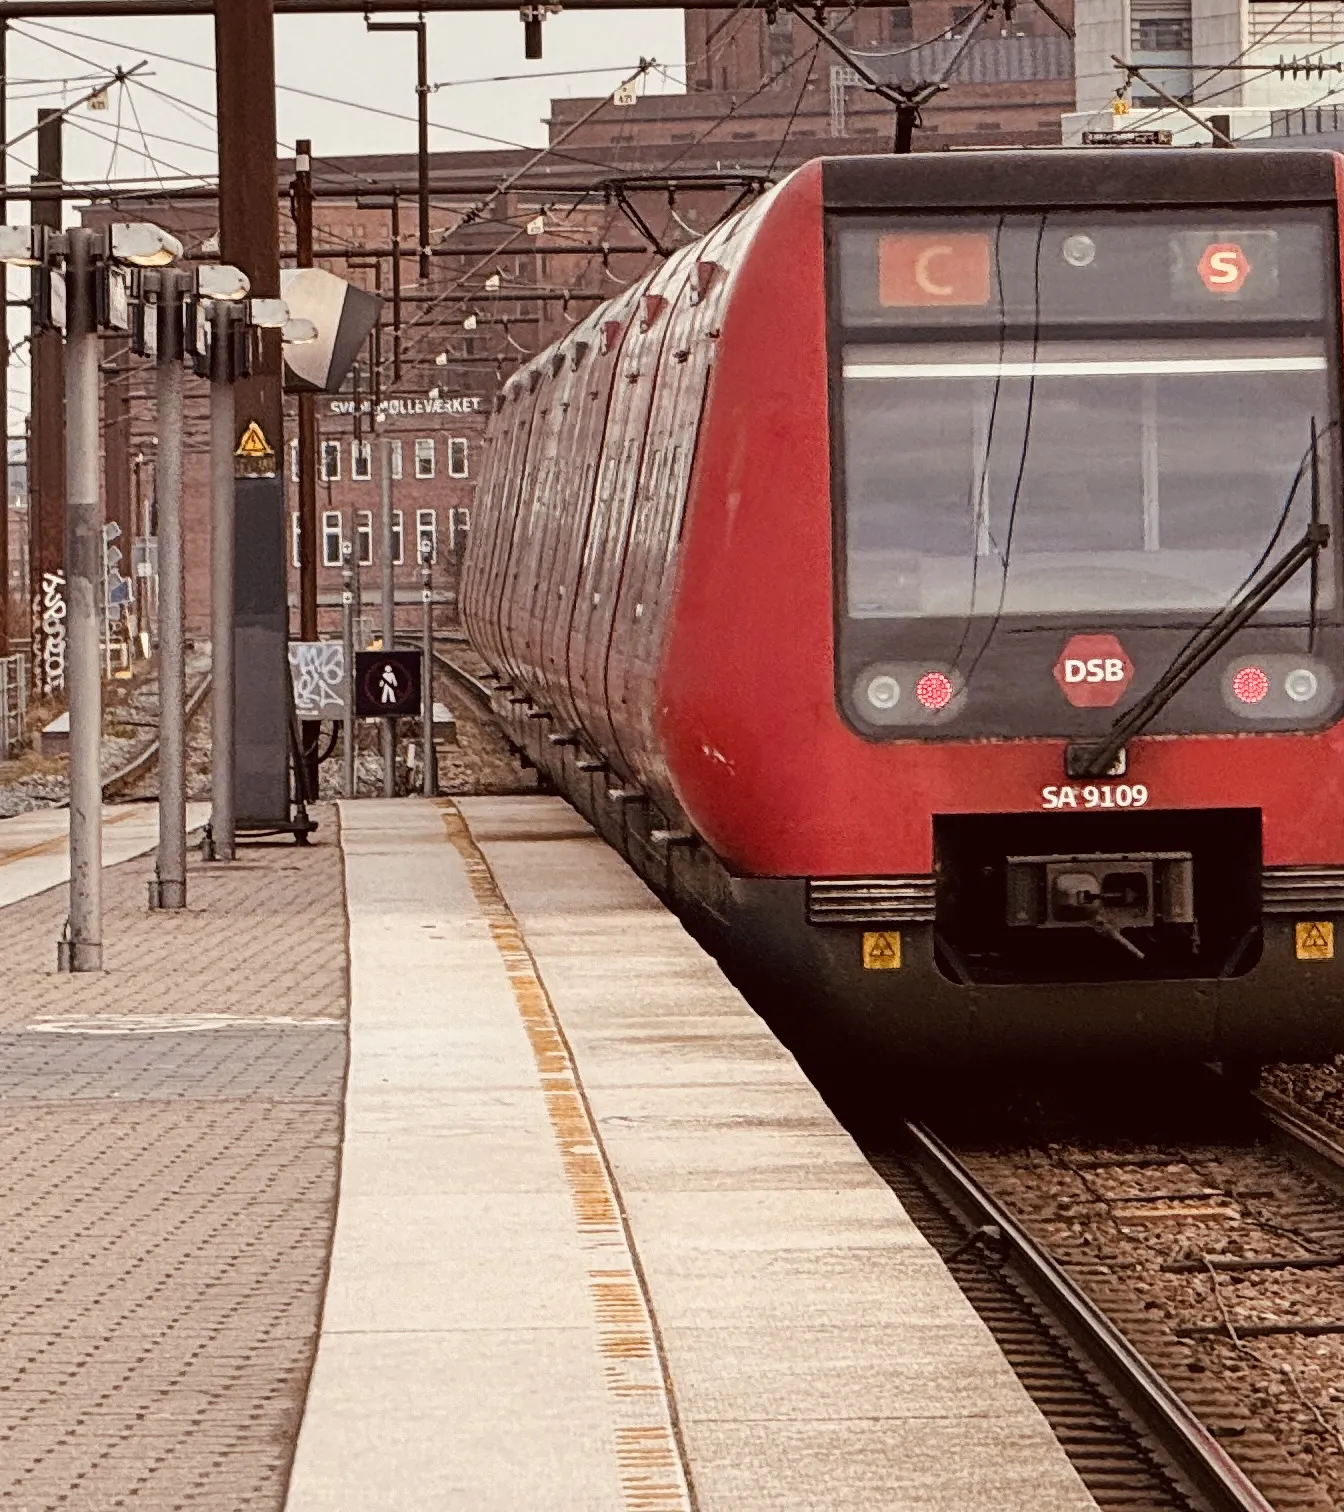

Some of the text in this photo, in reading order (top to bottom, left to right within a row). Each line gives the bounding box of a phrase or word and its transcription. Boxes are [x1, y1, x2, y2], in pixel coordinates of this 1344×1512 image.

[914, 245, 954, 296] C
[1208, 251, 1239, 284] S
[1063, 658, 1125, 683] DSB
[1042, 783, 1149, 809] SA 9109
